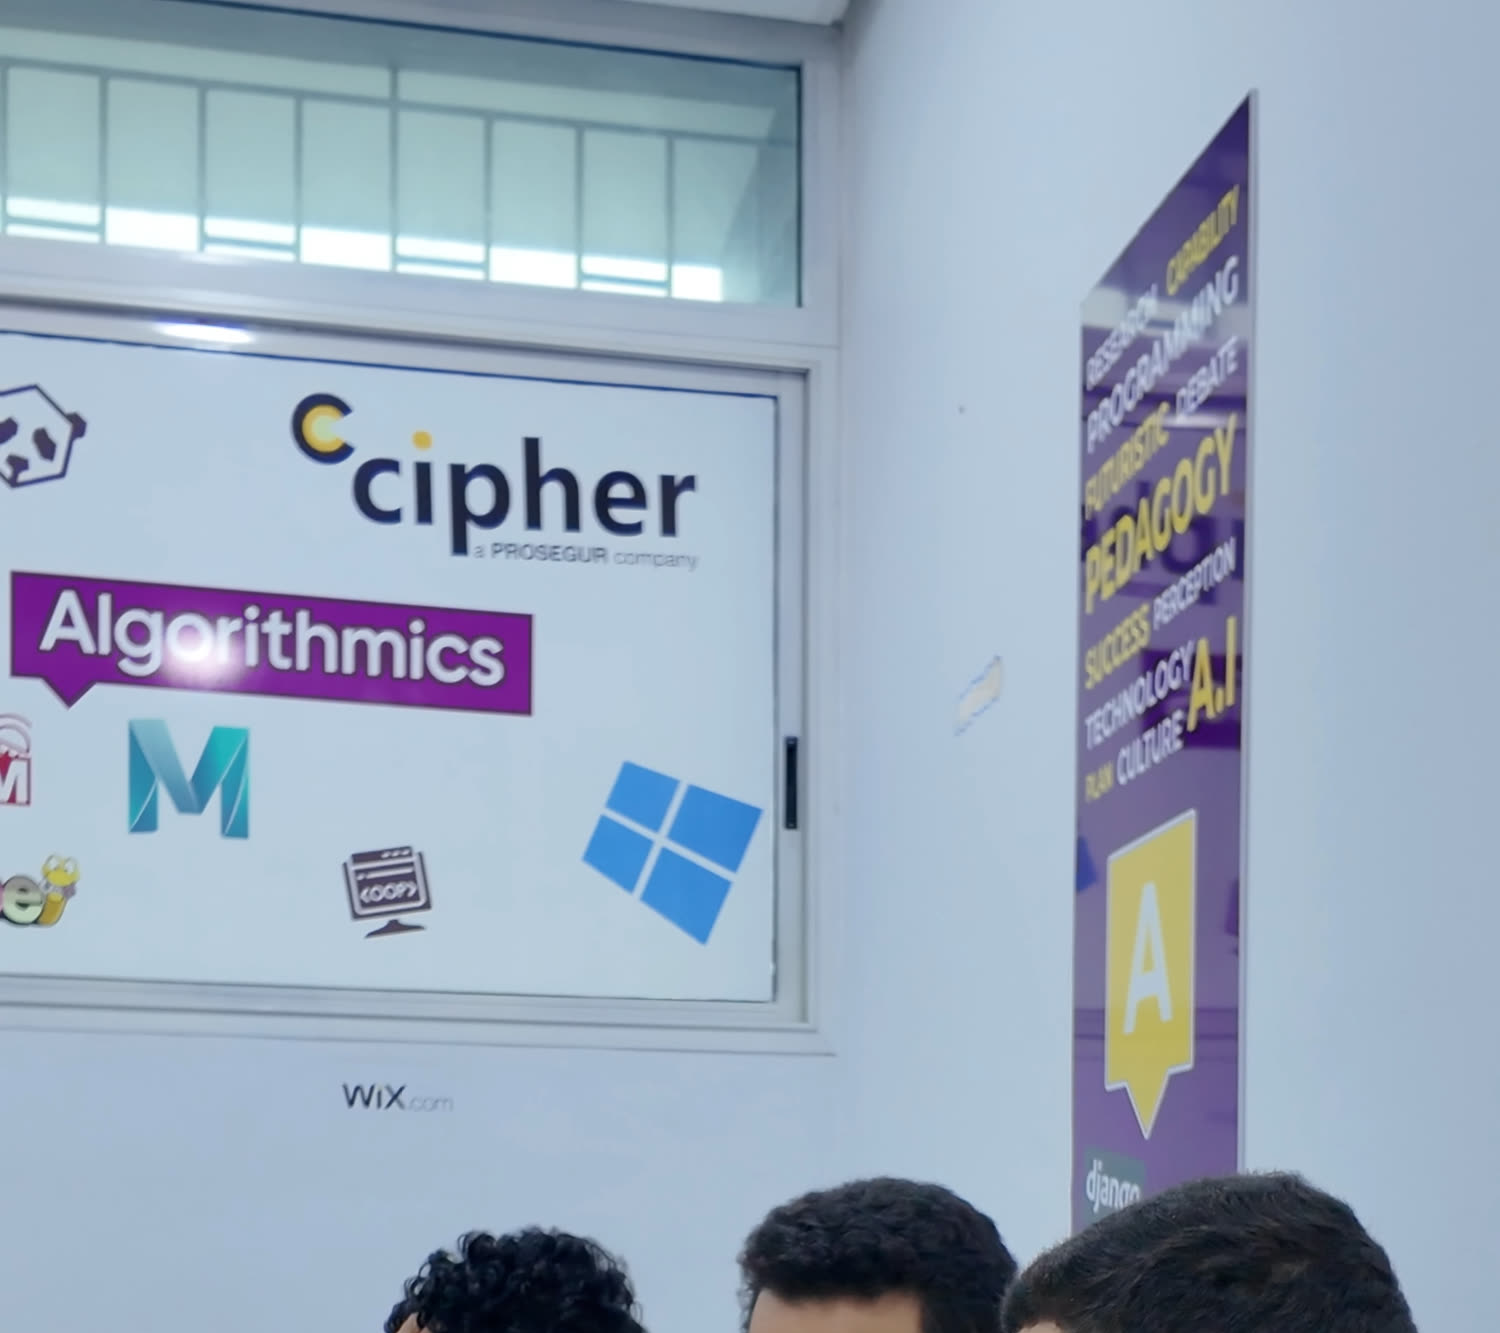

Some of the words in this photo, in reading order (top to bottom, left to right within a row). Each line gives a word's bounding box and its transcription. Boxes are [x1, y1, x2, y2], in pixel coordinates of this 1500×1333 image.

[1087, 255, 1239, 453] PROGRAMMING
[353, 430, 697, 557] cipher
[1085, 401, 1169, 520] FUTURISTIC
[1176, 336, 1238, 424] DEBATE
[473, 545, 486, 559] a
[491, 542, 608, 564] PROSEGUR
[613, 551, 698, 572] company
[1085, 411, 1237, 615] PEDAGOGY
[38, 589, 506, 688] Algorithmics
[1085, 603, 1149, 689] SUCCESS
[1153, 537, 1236, 630] PERCEPTION
[1085, 640, 1195, 749] TECHNOLOGY
[1117, 710, 1184, 785] CULTURE
[1122, 881, 1173, 1036] A
